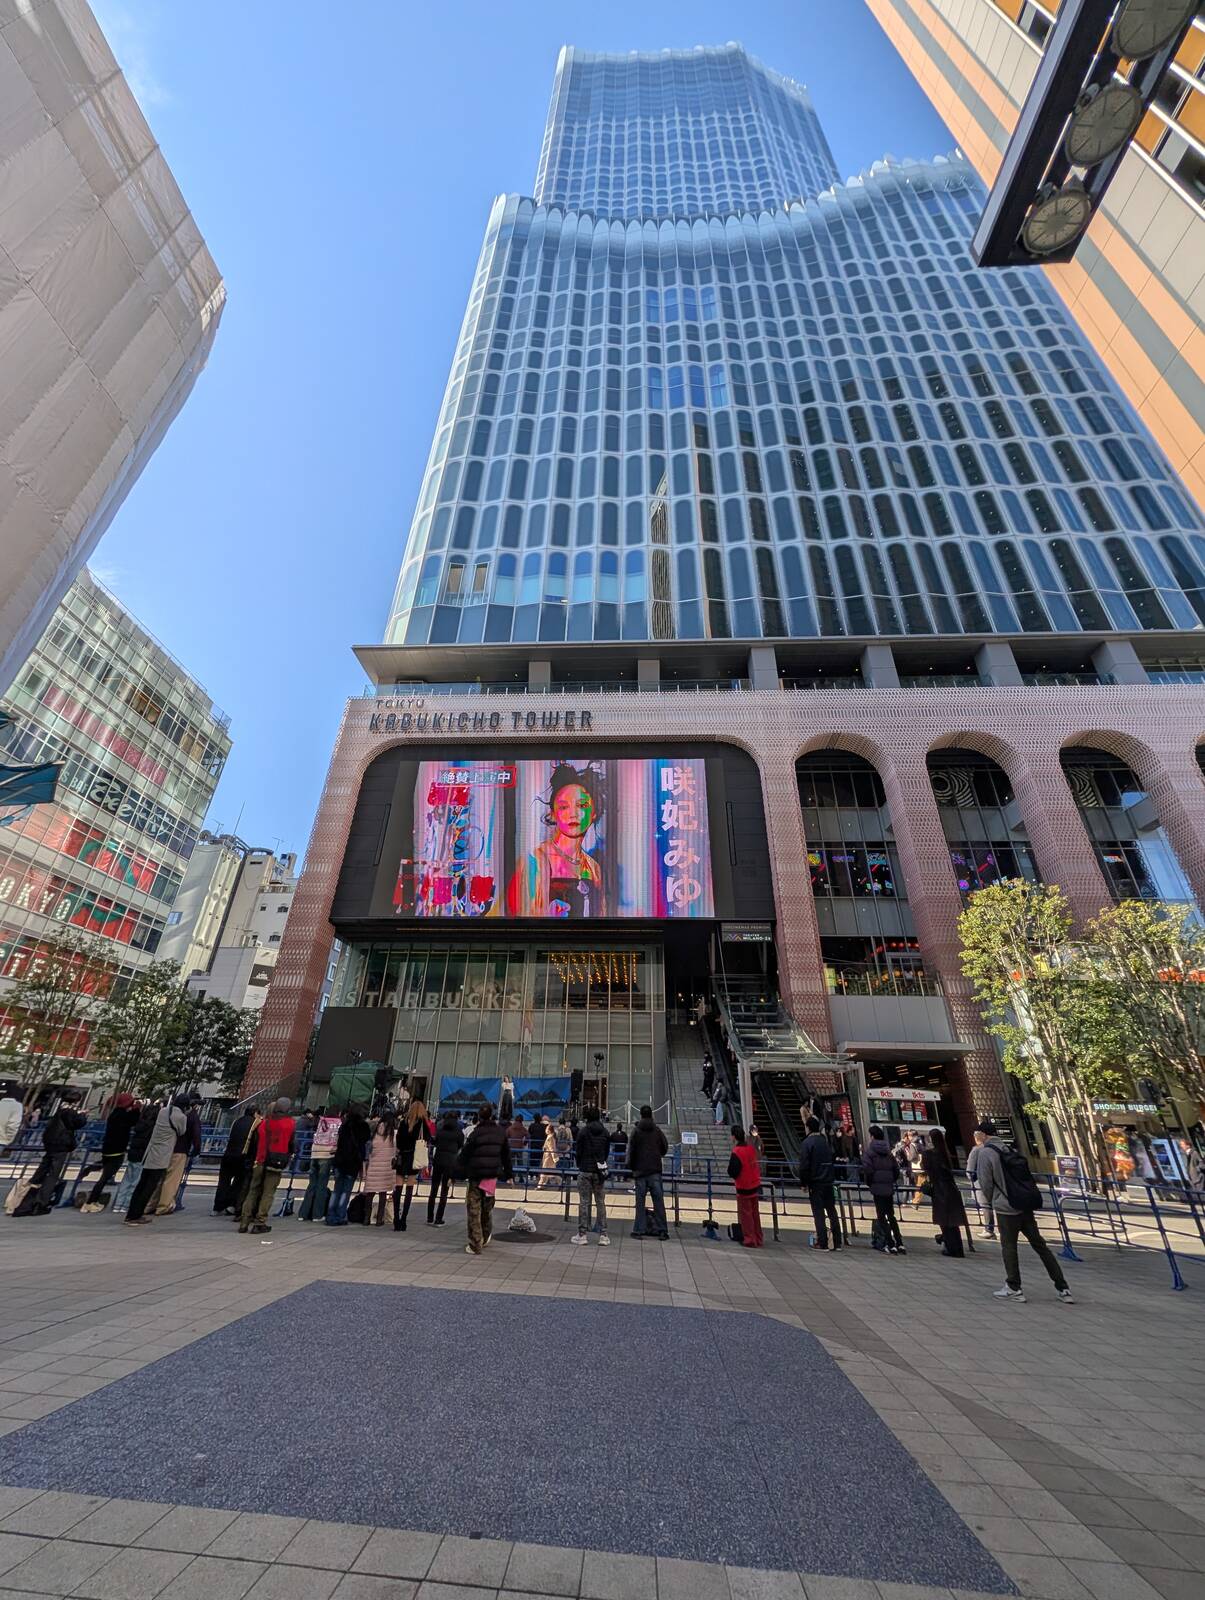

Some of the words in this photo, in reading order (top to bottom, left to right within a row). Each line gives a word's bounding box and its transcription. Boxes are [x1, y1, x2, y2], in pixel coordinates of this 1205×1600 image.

[369, 712, 501, 730] KABUKICHO
[511, 710, 593, 729] TOWER
[660, 766, 702, 908] 咲妃みゆ
[344, 991, 522, 1009] STARBUCKS
